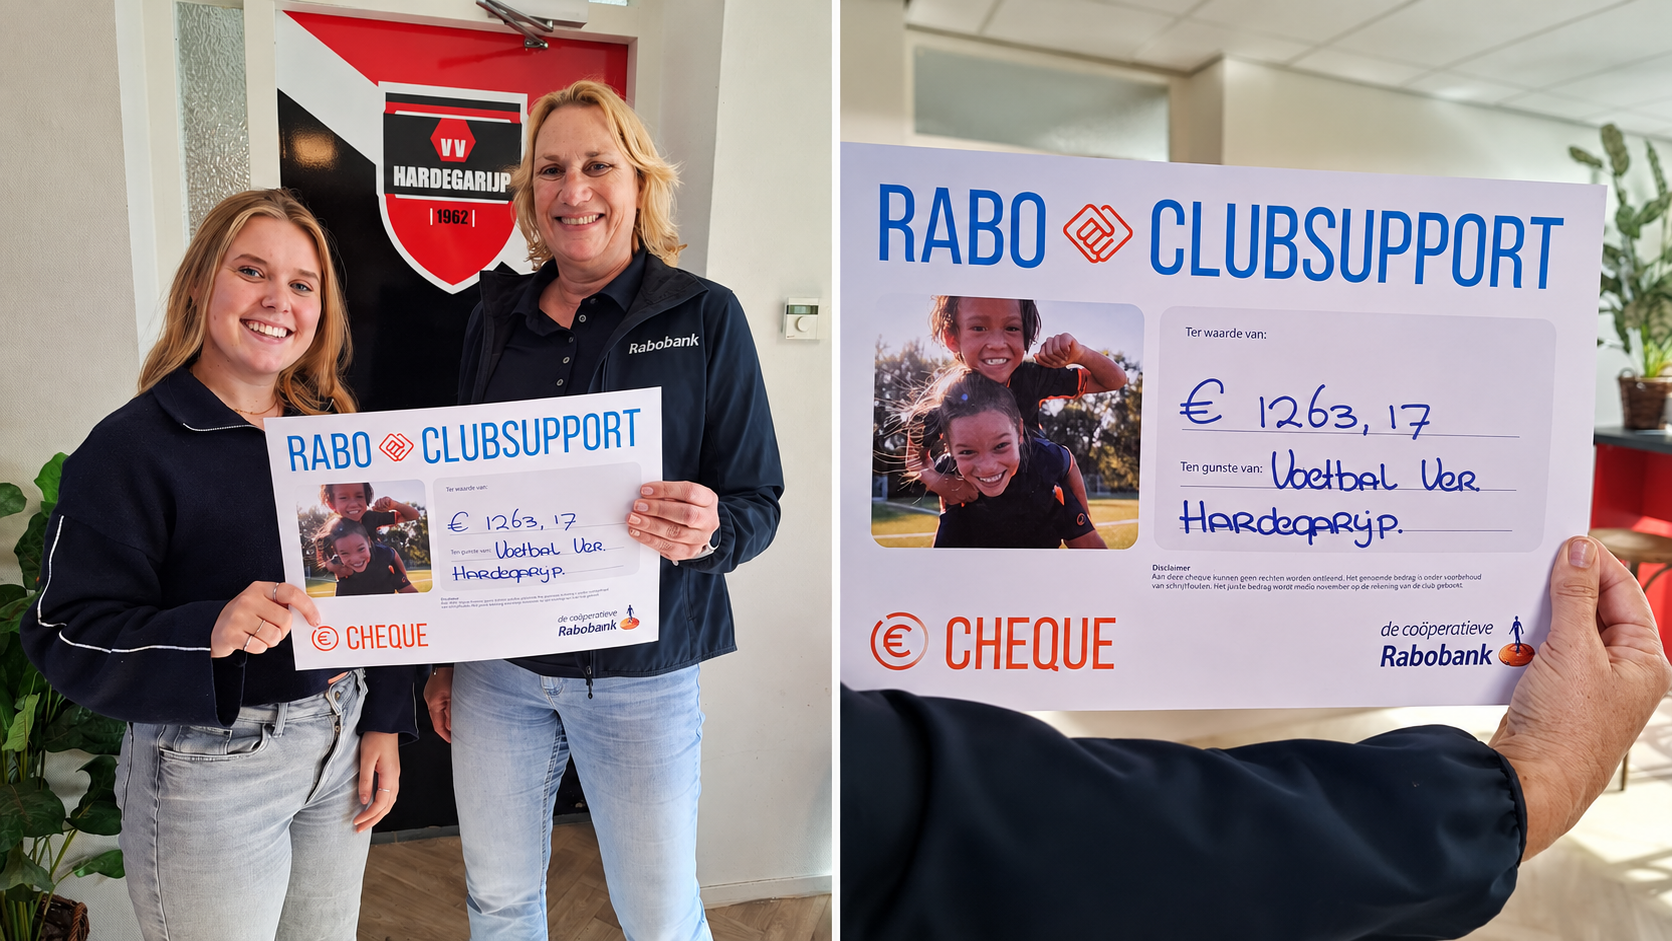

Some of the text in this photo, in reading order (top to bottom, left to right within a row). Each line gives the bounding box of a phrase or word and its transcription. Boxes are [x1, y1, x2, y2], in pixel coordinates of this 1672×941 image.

[440, 138, 467, 158] VV
[393, 165, 512, 193] HARDEGARIJP
[436, 208, 469, 225] 1962
[878, 182, 1565, 291] RABO CLUBSUPPORT
[1185, 326, 1267, 340] Ter waarde van:
[628, 333, 700, 355] Rabobank
[1388, 403, 1431, 441] 17
[286, 407, 642, 473] RABO CLUBSUPPORT
[1180, 461, 1263, 476] Ten gunste van:
[1151, 573, 1166, 581] Aan
[1240, 575, 1257, 583] geen
[1393, 574, 1417, 582] bedrag
[1152, 564, 1191, 572] Disclaimer
[1247, 583, 1272, 592] bedrag
[1316, 583, 1350, 591] november
[1350, 584, 1360, 592] op
[557, 614, 569, 624] de
[558, 619, 617, 637] Rabobank
[346, 622, 429, 651] CHEQUE
[1380, 620, 1494, 640] de coöperatieve
[945, 615, 1117, 673] CHEQUE
[1380, 643, 1494, 668] Rabobank
